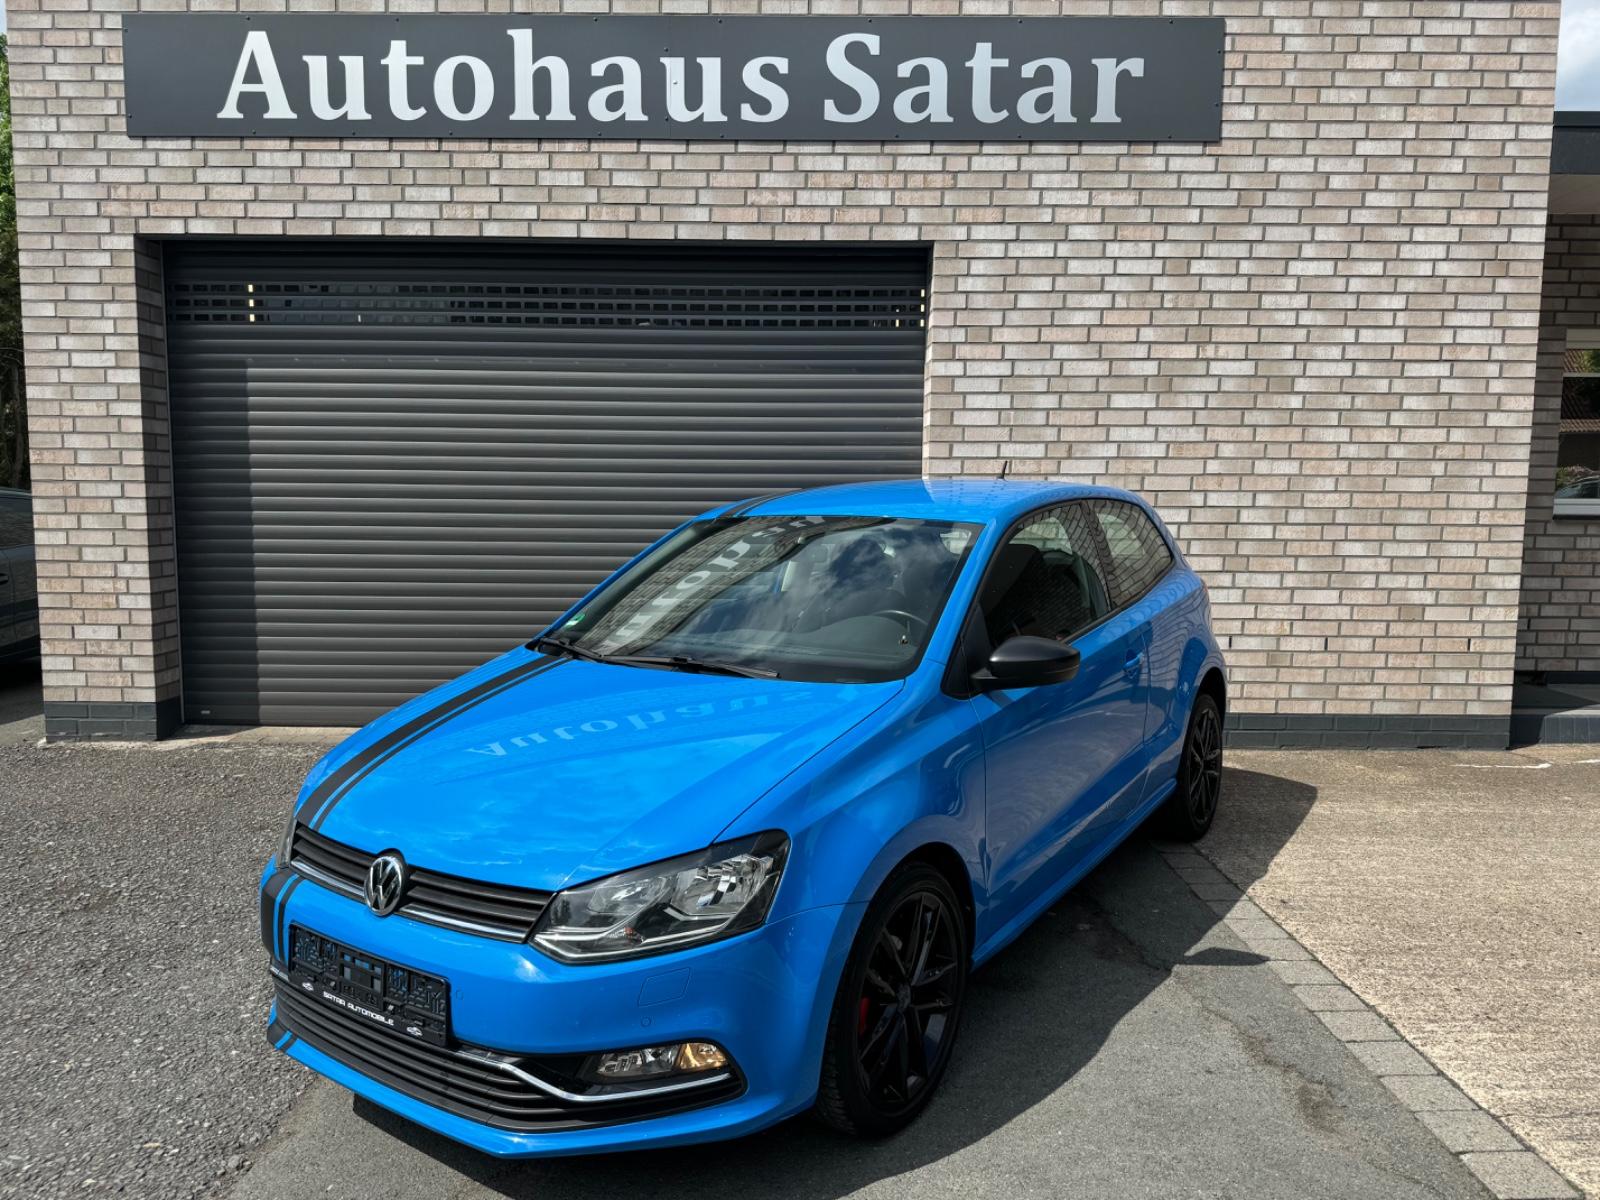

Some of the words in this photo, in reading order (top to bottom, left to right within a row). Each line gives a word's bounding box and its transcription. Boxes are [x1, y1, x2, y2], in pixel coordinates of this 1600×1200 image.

[216, 28, 789, 122] Autohaus
[824, 32, 1145, 123] Satar
[347, 1003, 394, 1026] AUTOMOBILE
